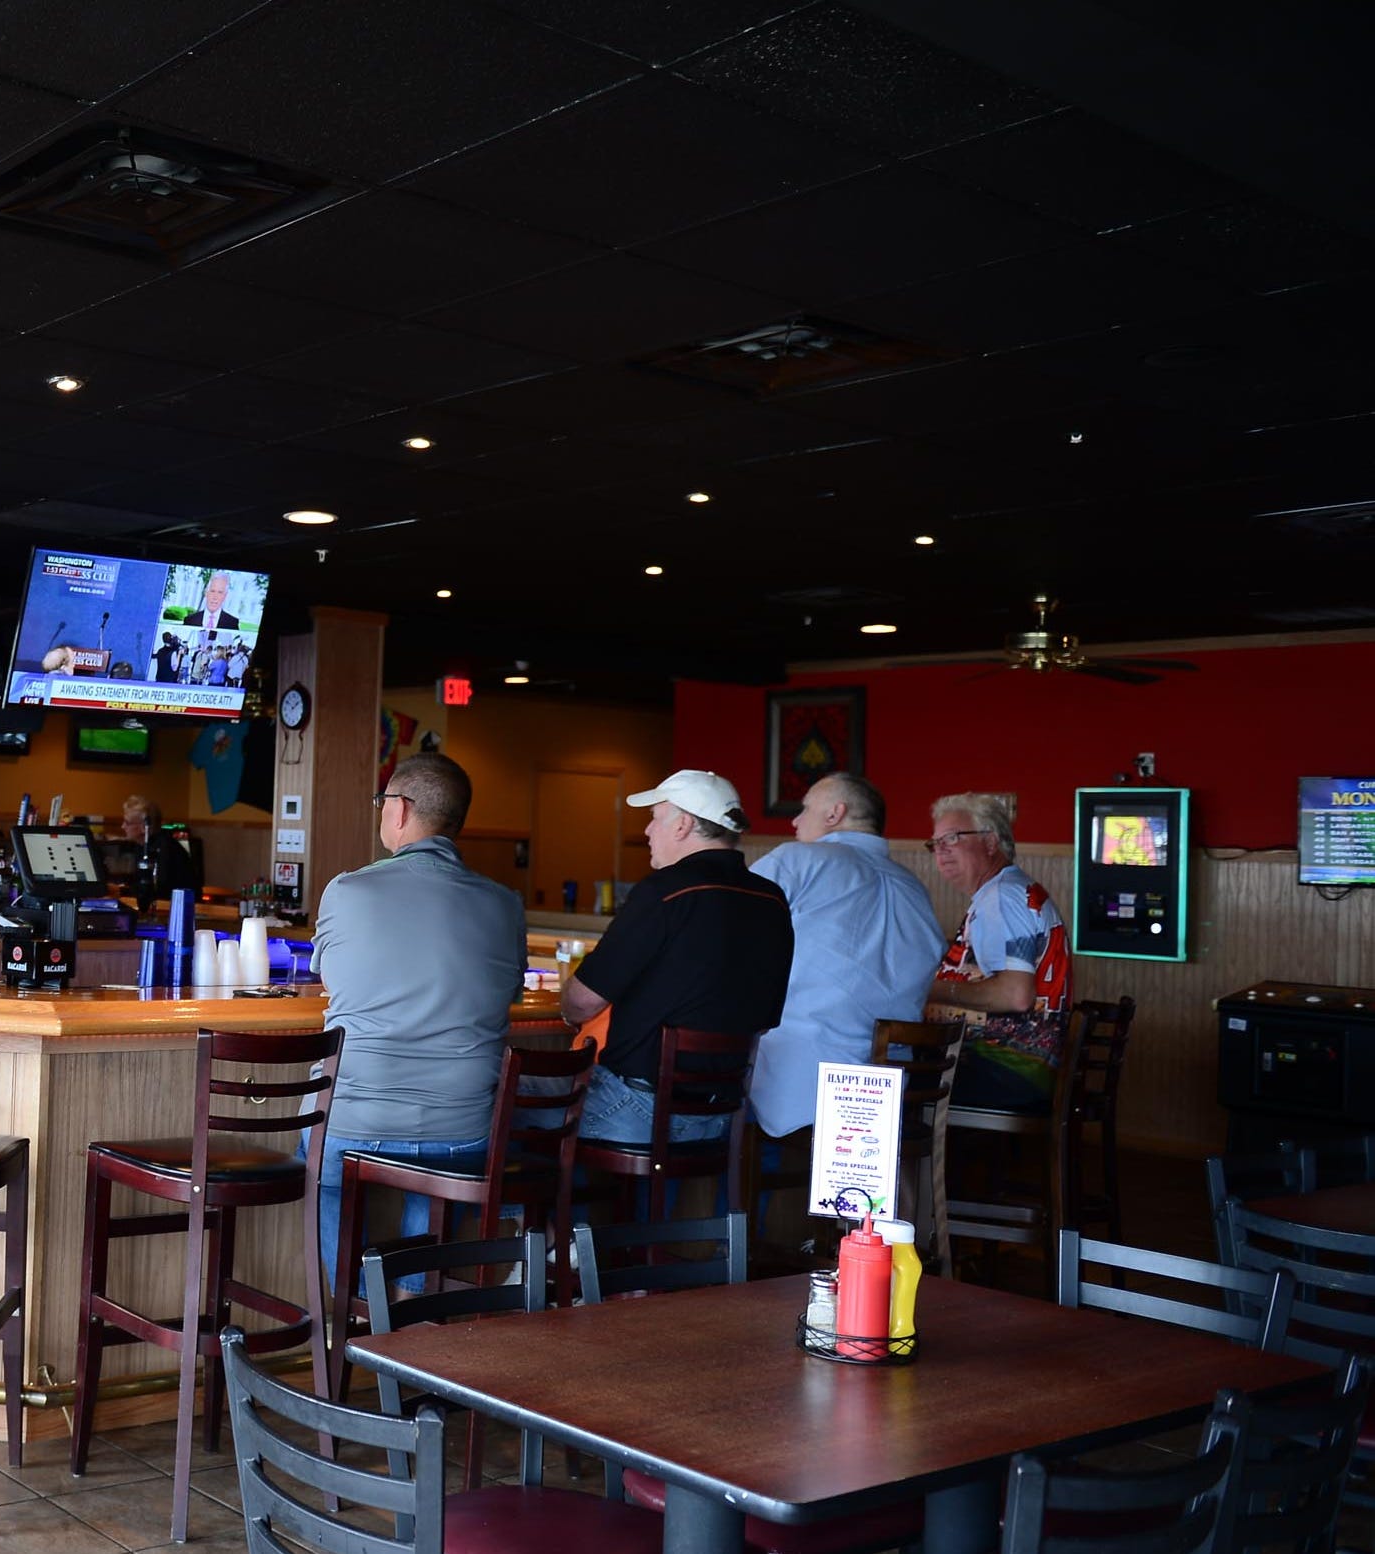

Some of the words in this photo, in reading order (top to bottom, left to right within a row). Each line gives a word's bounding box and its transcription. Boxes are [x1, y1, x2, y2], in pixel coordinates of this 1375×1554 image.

[47, 555, 93, 567] WASHINGTON
[60, 684, 93, 697] AWAITING
[95, 686, 131, 699] STATEMENT
[132, 688, 148, 700] FROM
[151, 690, 166, 701] PRES
[192, 693, 218, 705] OUTSIDE
[218, 695, 233, 706] ATTY
[106, 701, 126, 709] FOX
[128, 702, 156, 711] NEWS
[157, 704, 187, 713] ALERT
[1331, 792, 1375, 806] MON
[827, 1073, 861, 1085] HAPPY
[864, 1076, 892, 1088] HOUR
[850, 1163, 878, 1171] SPECIALS
